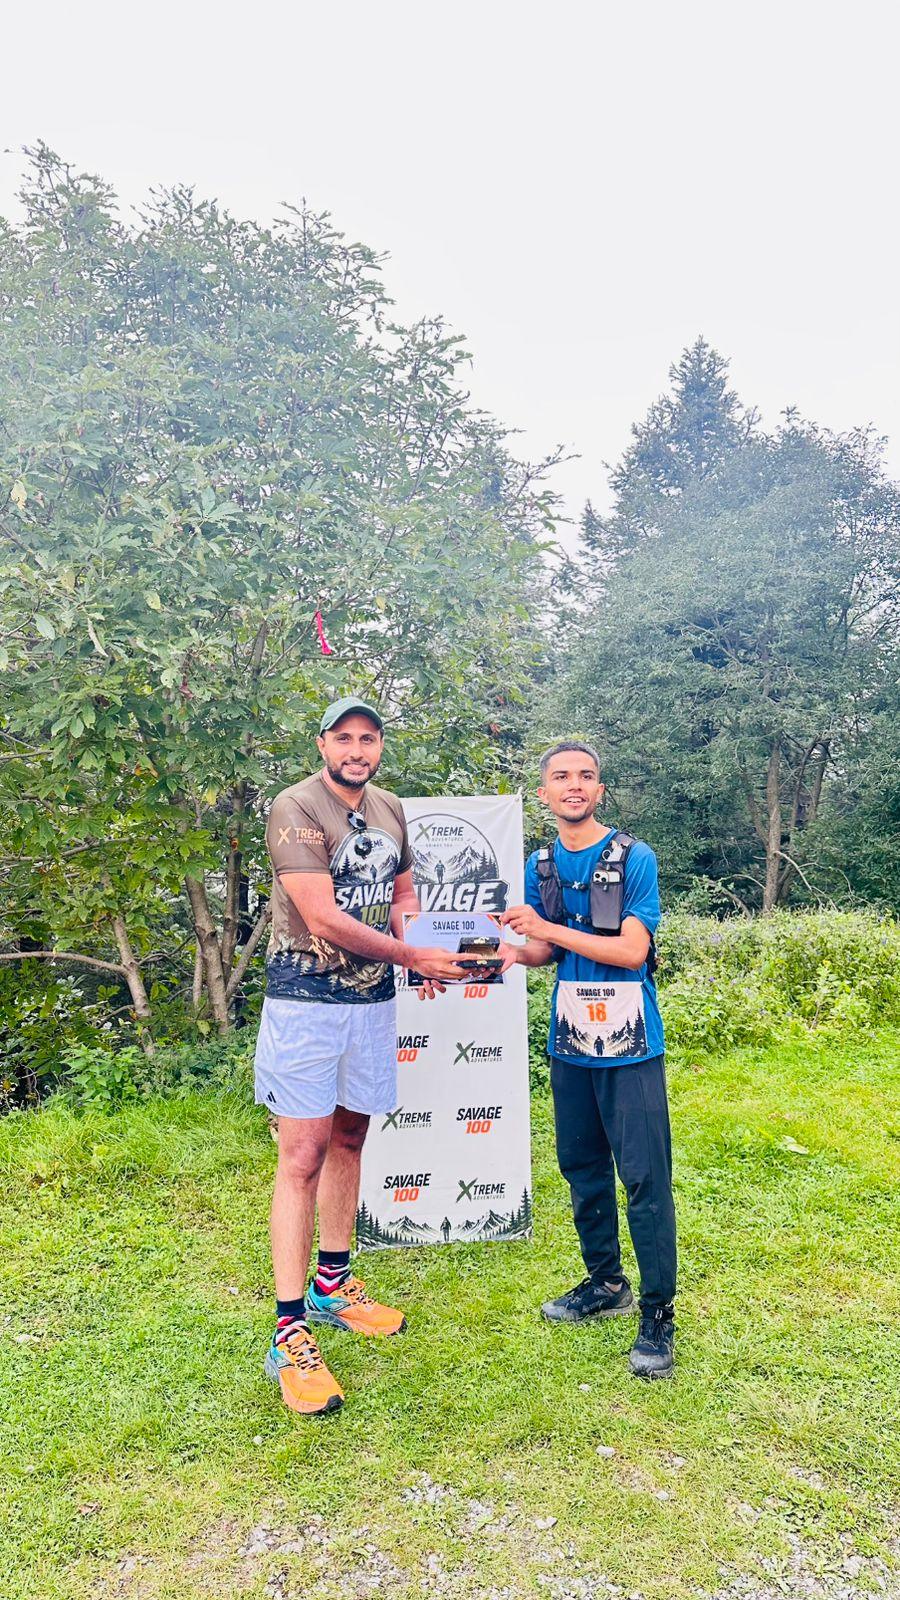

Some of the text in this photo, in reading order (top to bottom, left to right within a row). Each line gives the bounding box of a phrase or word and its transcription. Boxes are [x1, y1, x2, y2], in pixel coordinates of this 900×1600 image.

[414, 823, 464, 842] XTREME
[335, 881, 394, 910] SAVAG
[415, 882, 500, 911] VAGE
[360, 903, 390, 925] 100
[432, 920, 475, 930] SAVAGE 100
[464, 985, 488, 998] 100
[576, 988, 615, 996] SAVAGE 100
[586, 1002, 606, 1022] 18
[397, 1035, 429, 1048] VAGE
[397, 1049, 417, 1062] 00
[453, 1041, 503, 1065] XTREME
[380, 1106, 432, 1132] XTREME
[456, 1106, 502, 1121] SAVAGE
[466, 1120, 491, 1134] 100
[383, 1173, 431, 1189] SAVAGE
[393, 1188, 419, 1202] 100
[456, 1178, 506, 1203] XTREME
